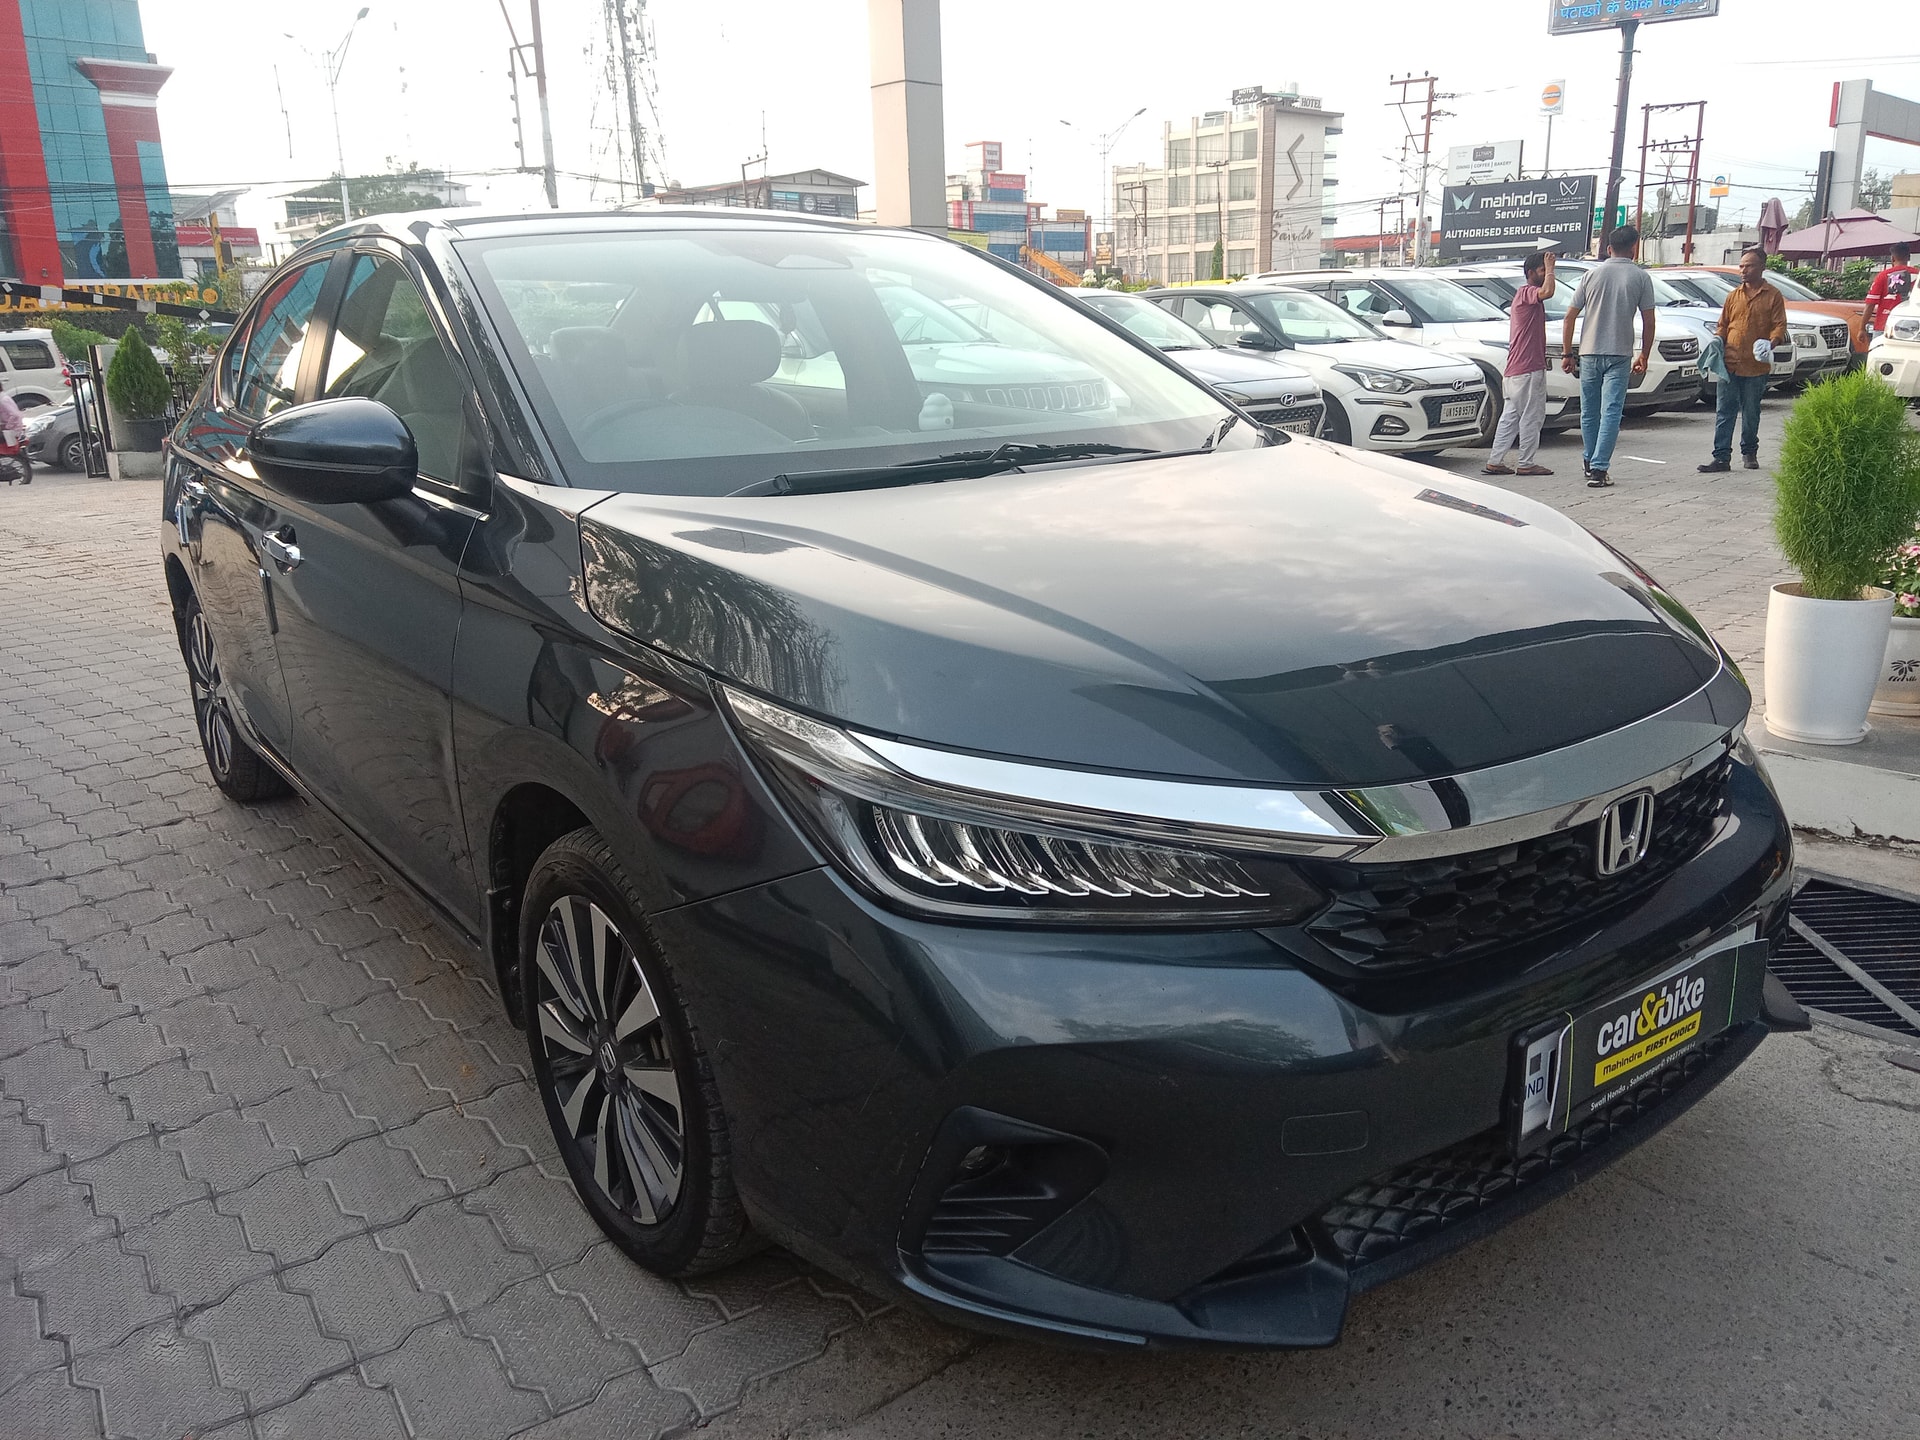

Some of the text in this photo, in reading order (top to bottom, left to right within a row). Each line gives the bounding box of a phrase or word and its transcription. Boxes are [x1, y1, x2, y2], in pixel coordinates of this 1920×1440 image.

[1301, 97, 1322, 108] HOTEL
[1480, 191, 1548, 208] mahindra
[1495, 208, 1530, 219] Service
[1445, 222, 1582, 239] AUTHORISED SERVICE CENTER
[1597, 975, 1705, 1056] car&bike
[1603, 1020, 1697, 1076] Mahindra FIRST CHOICE
